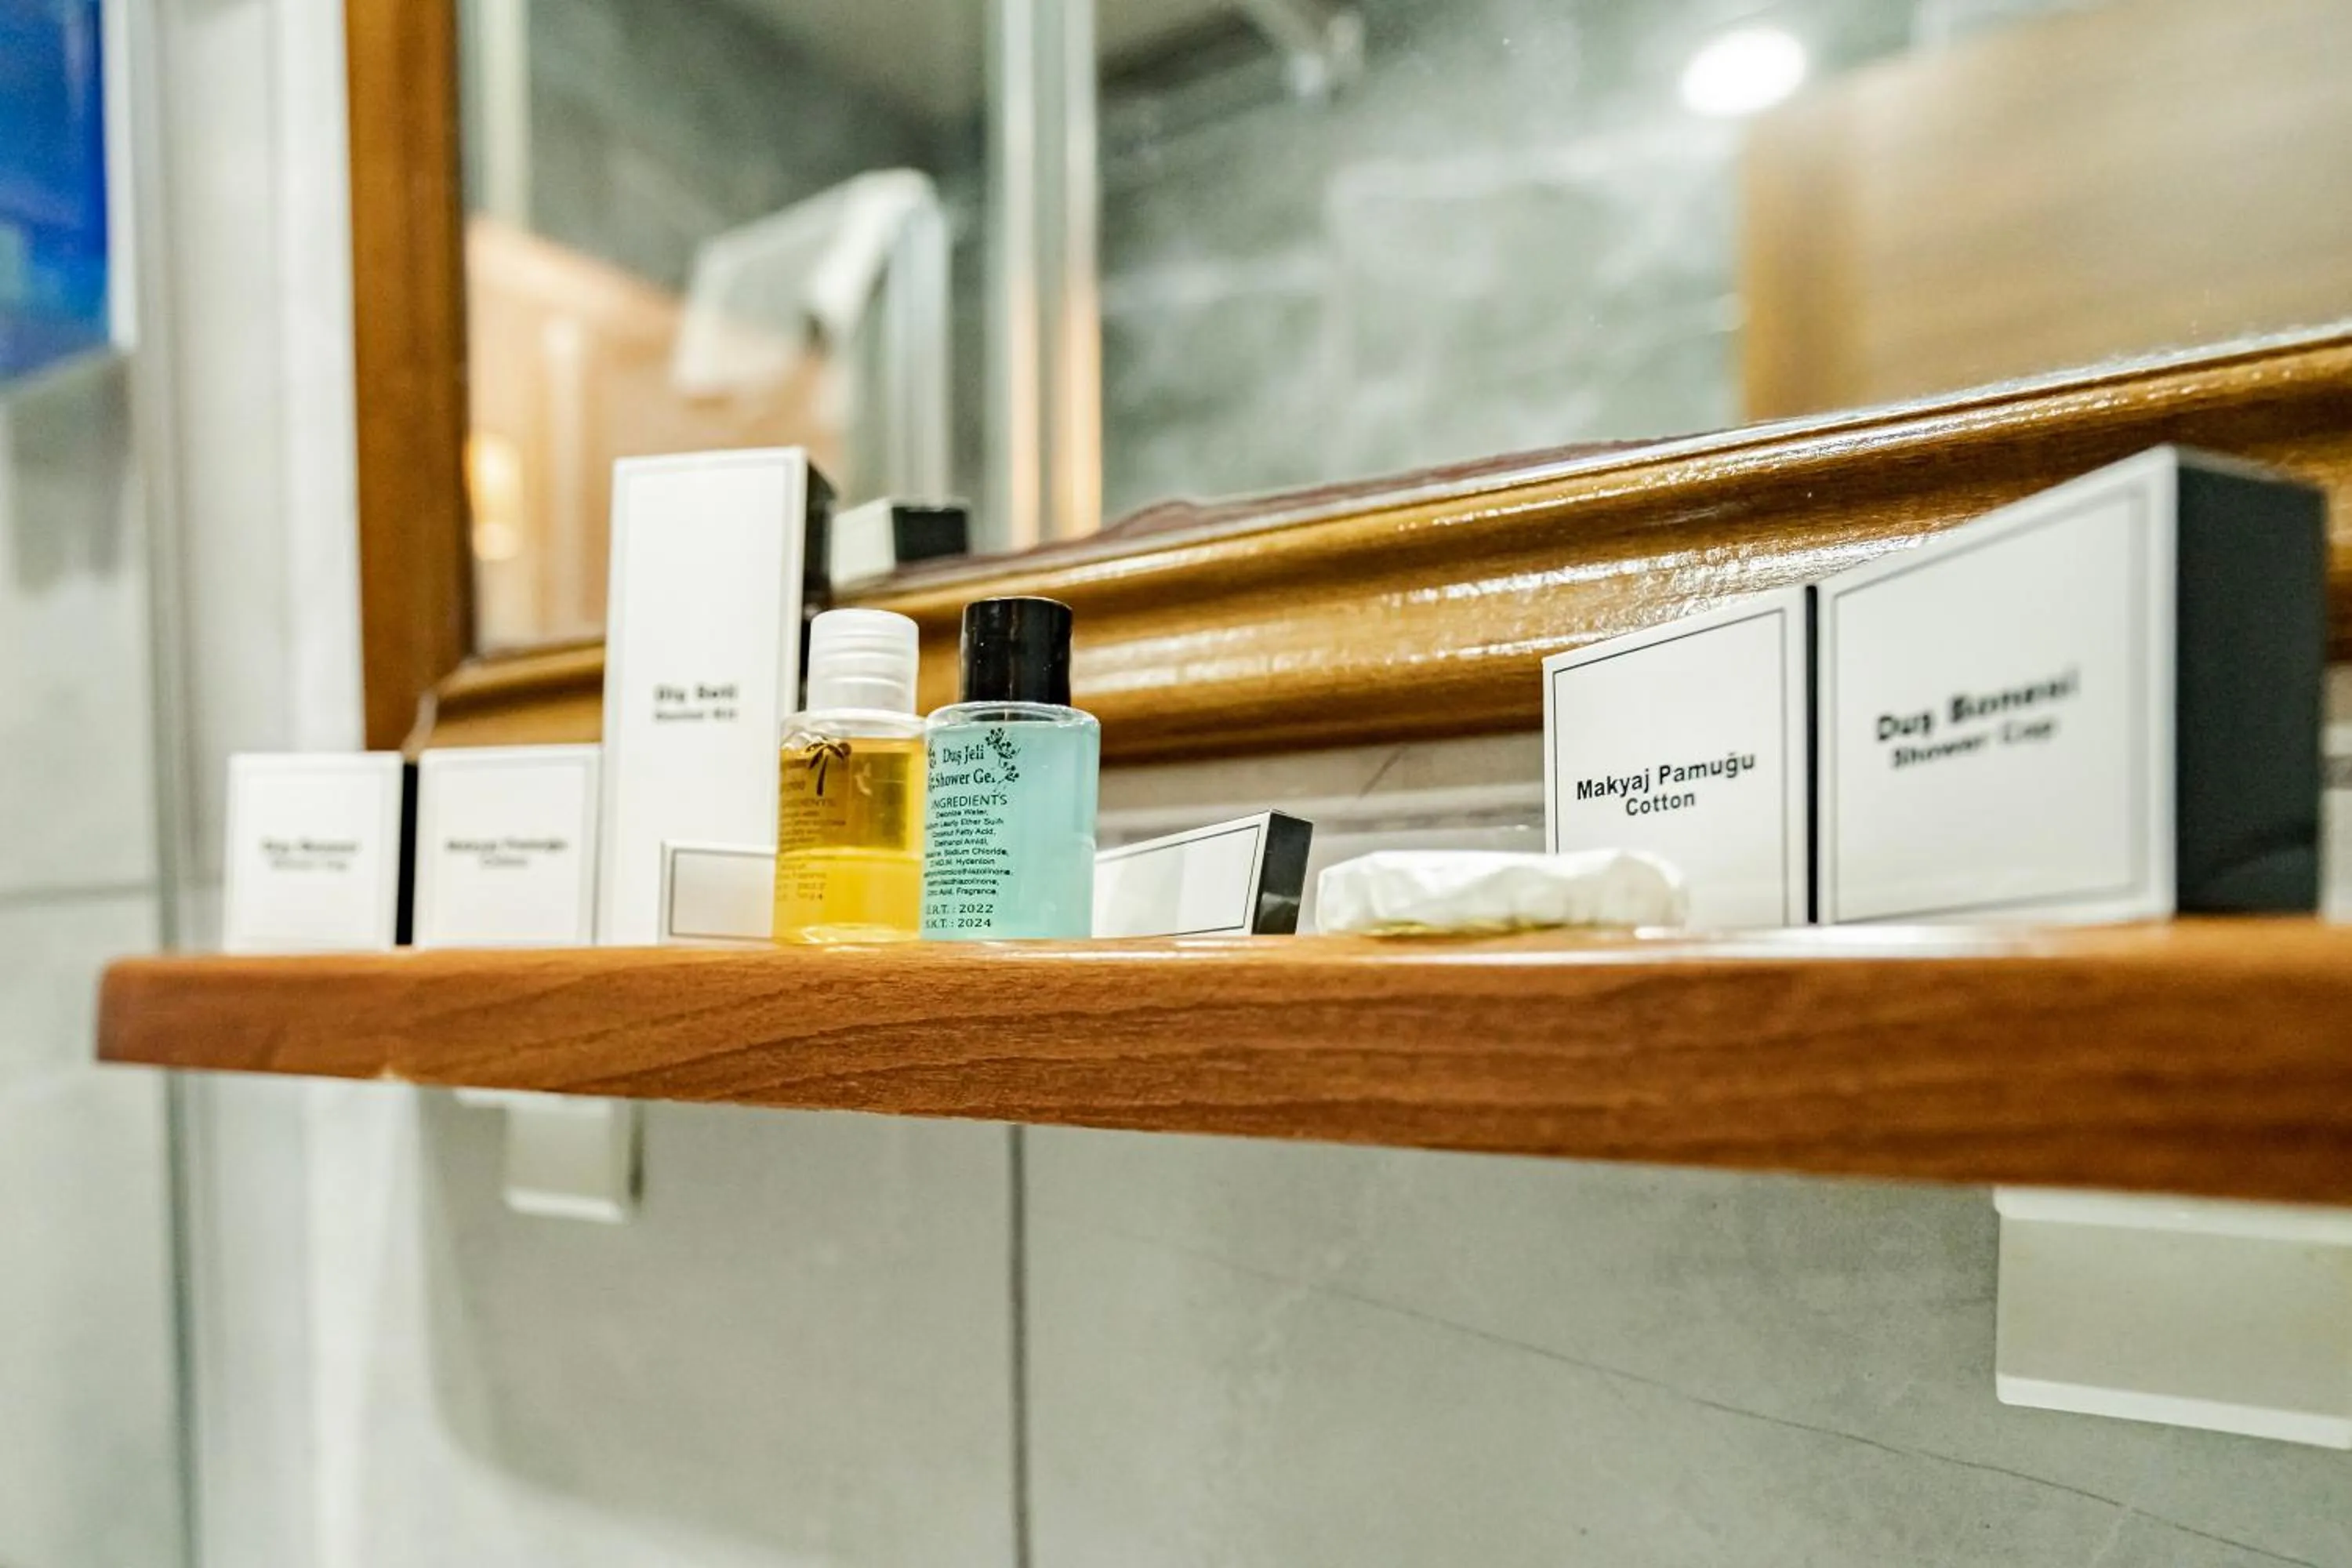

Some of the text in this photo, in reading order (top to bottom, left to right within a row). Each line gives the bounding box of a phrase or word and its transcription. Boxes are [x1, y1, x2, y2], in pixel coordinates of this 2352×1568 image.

[964, 744, 984, 764] Jeli
[936, 771, 971, 787] Shower
[1577, 752, 1755, 800] Makyaj Pamuğu
[1625, 791, 1696, 816] Cotton
[959, 903, 994, 914] 2022
[957, 918, 992, 928] 2024
